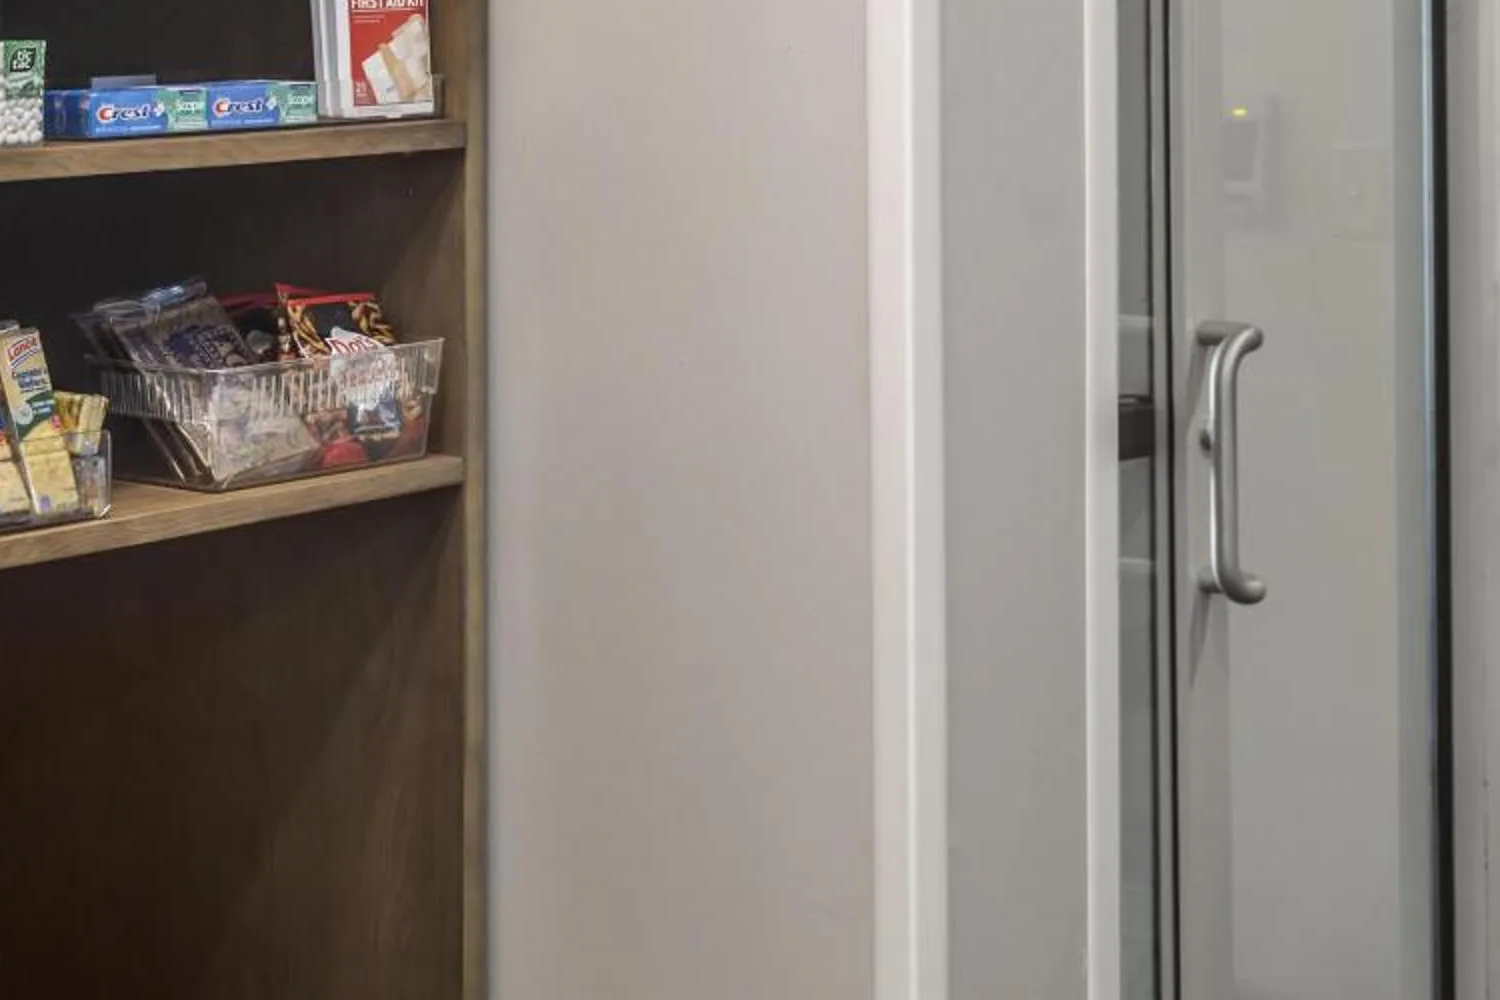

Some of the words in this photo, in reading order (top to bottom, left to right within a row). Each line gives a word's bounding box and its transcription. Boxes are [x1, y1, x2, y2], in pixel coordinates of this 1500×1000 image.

[12, 57, 30, 71] tac
[17, 47, 33, 62] tic
[95, 102, 151, 123] Crest
[212, 97, 264, 118] Crest
[7, 335, 39, 360] Lance
